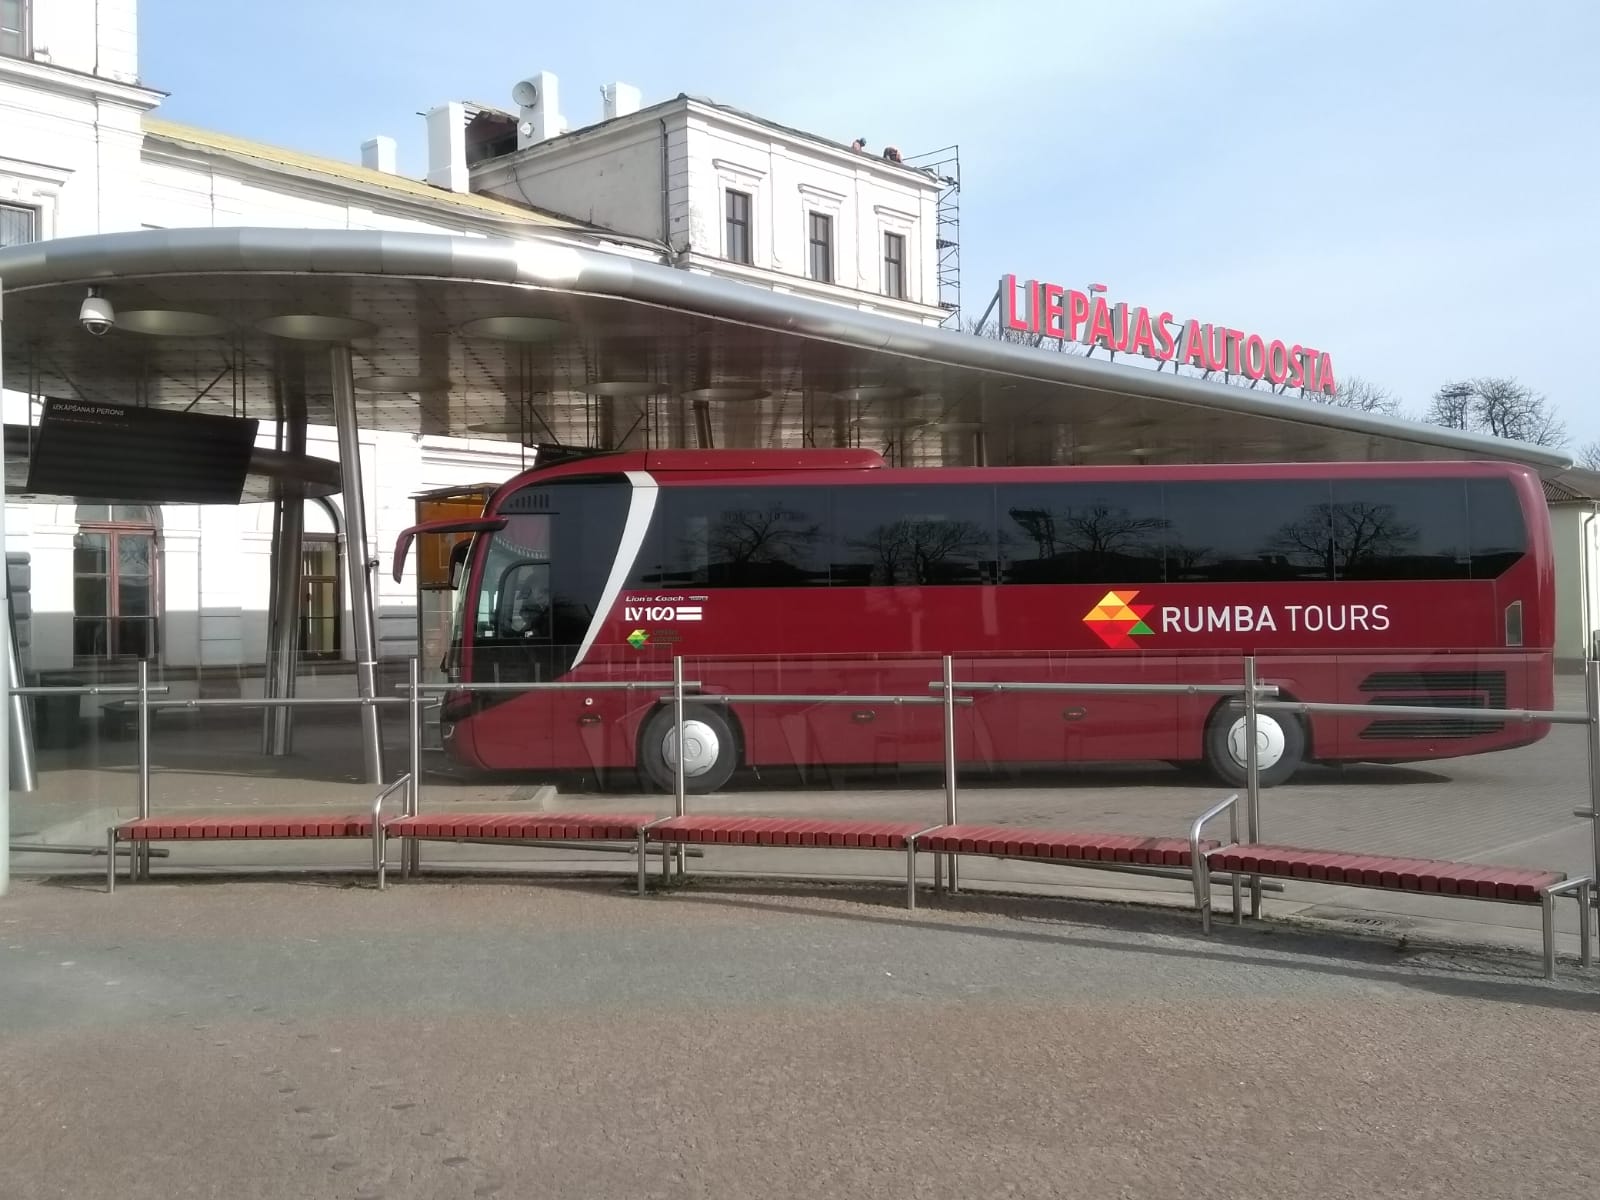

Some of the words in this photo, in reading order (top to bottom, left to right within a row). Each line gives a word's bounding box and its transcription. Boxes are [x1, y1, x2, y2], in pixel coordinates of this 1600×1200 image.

[1002, 273, 1175, 361] LIEPĀJAS
[1178, 319, 1336, 395] AUTOOSTA
[1162, 605, 1277, 632] RUMBA
[1284, 604, 1391, 631] TOURS
